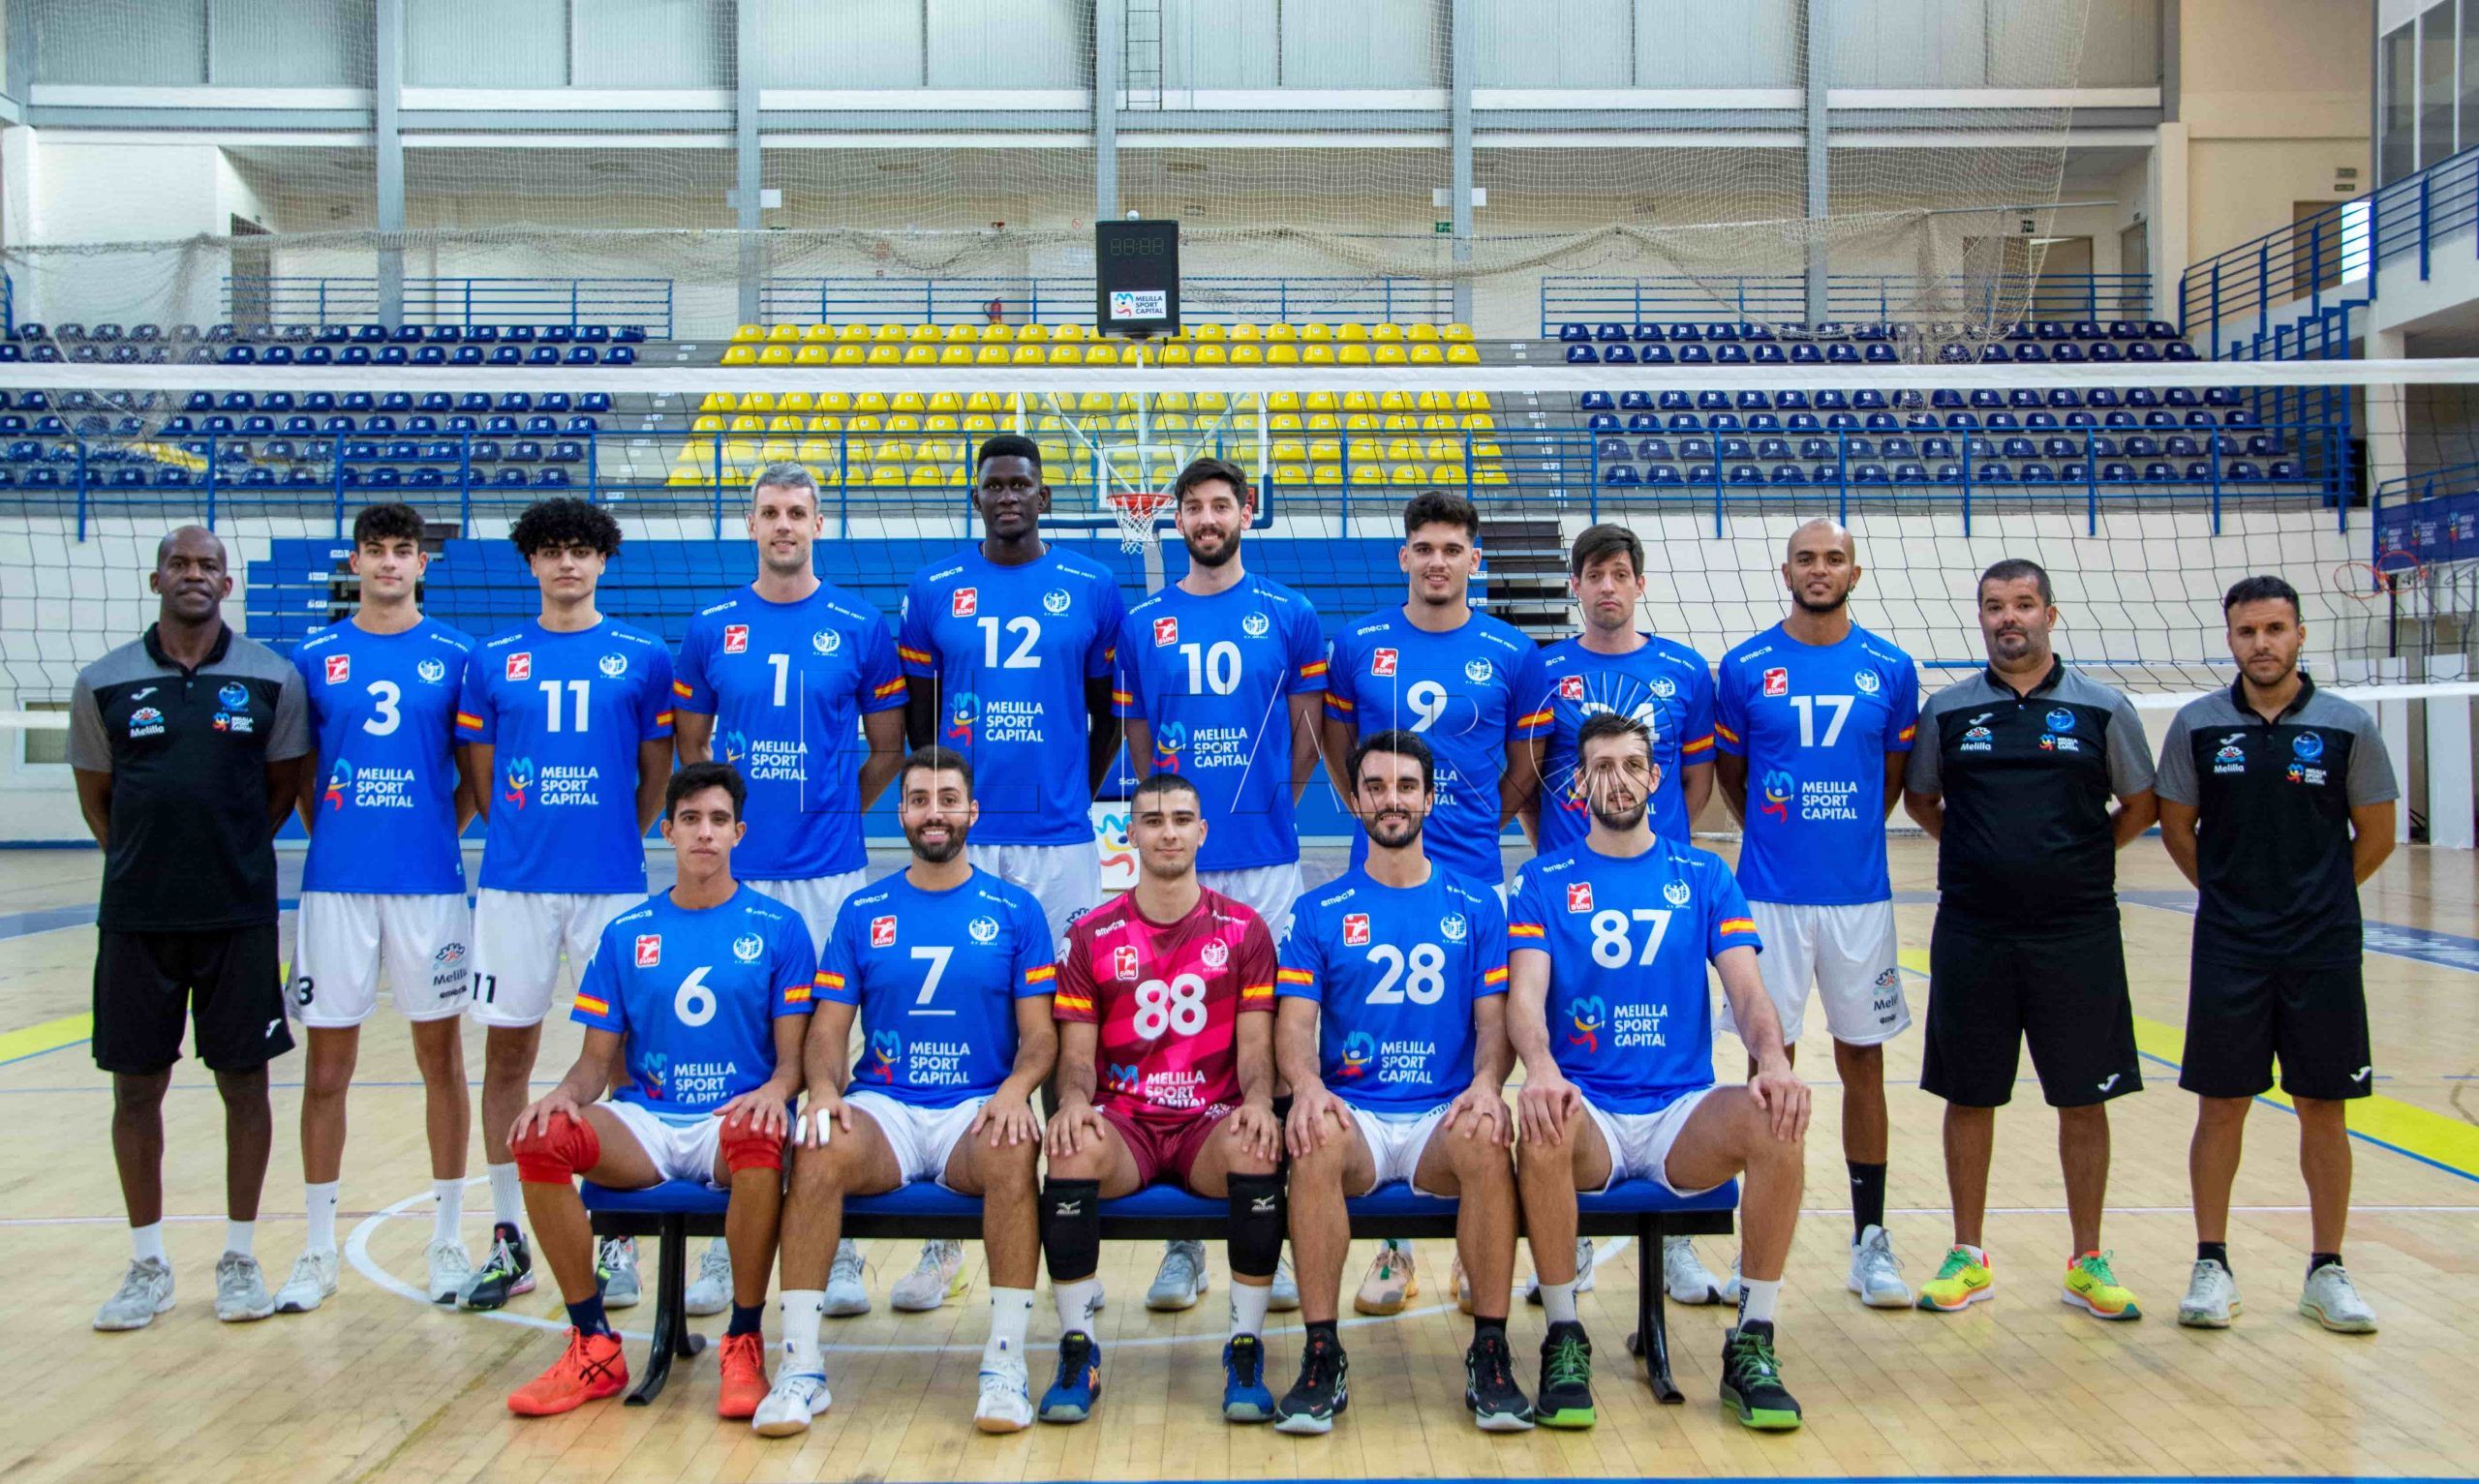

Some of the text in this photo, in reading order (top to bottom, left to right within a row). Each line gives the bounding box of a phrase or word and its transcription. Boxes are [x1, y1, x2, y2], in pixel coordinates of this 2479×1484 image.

[976, 616, 1042, 668] 12
[1179, 641, 1242, 696] 10
[768, 653, 790, 707] 1
[363, 681, 400, 735] 3
[539, 681, 589, 732] 11
[987, 702, 1043, 713] MELILLA
[1407, 681, 1447, 732] 9
[987, 715, 1033, 727] SPORT
[1580, 702, 1660, 742] 4
[1790, 695, 1854, 746] 17
[130, 725, 165, 738] Melilla
[986, 729, 1043, 742] CAPITAL
[1194, 728, 1247, 741] MELILLA
[752, 739, 807, 755] MELILLA
[1195, 742, 1239, 754] SPORT
[1960, 742, 1992, 751] Melilla
[752, 754, 797, 766] SPORT
[1195, 754, 1251, 769] CAPITAL
[541, 767, 597, 778] MELILLA
[751, 766, 807, 781] CAPITAL
[2214, 764, 2245, 773] Melilla
[357, 769, 413, 782] MELILLA
[356, 781, 403, 793] SPORT
[541, 779, 588, 792] SPORT
[1802, 782, 1857, 793] MELILLA
[355, 795, 413, 806] CAPITAL
[541, 793, 597, 804] CAPITAL
[1803, 795, 1848, 806] SPORT
[1802, 808, 1857, 819] CAPITAL
[1590, 909, 1672, 969] 87
[911, 947, 953, 1004] 7
[1365, 943, 1446, 1005] 28
[298, 977, 315, 1006] 3
[473, 972, 496, 1004] 11
[675, 967, 716, 1026] 6
[1133, 973, 1208, 1040] 88
[1614, 1005, 1668, 1017] MELILLA
[1615, 1019, 1659, 1032] SPORT
[1615, 1034, 1665, 1045] CAPITAL
[910, 1043, 969, 1055] MELILLA
[1381, 1042, 1435, 1054] MELILLA
[910, 1056, 959, 1070] SPORT
[1383, 1056, 1425, 1068] SPORT
[675, 1063, 736, 1076] MELILLA
[909, 1071, 968, 1084] CAPITAL
[1146, 1071, 1207, 1085] MELILLA
[1379, 1070, 1432, 1083] CAPITAL
[676, 1077, 724, 1091] SPORT
[1145, 1085, 1195, 1099] SPORT
[677, 1093, 733, 1105] CAPITA
